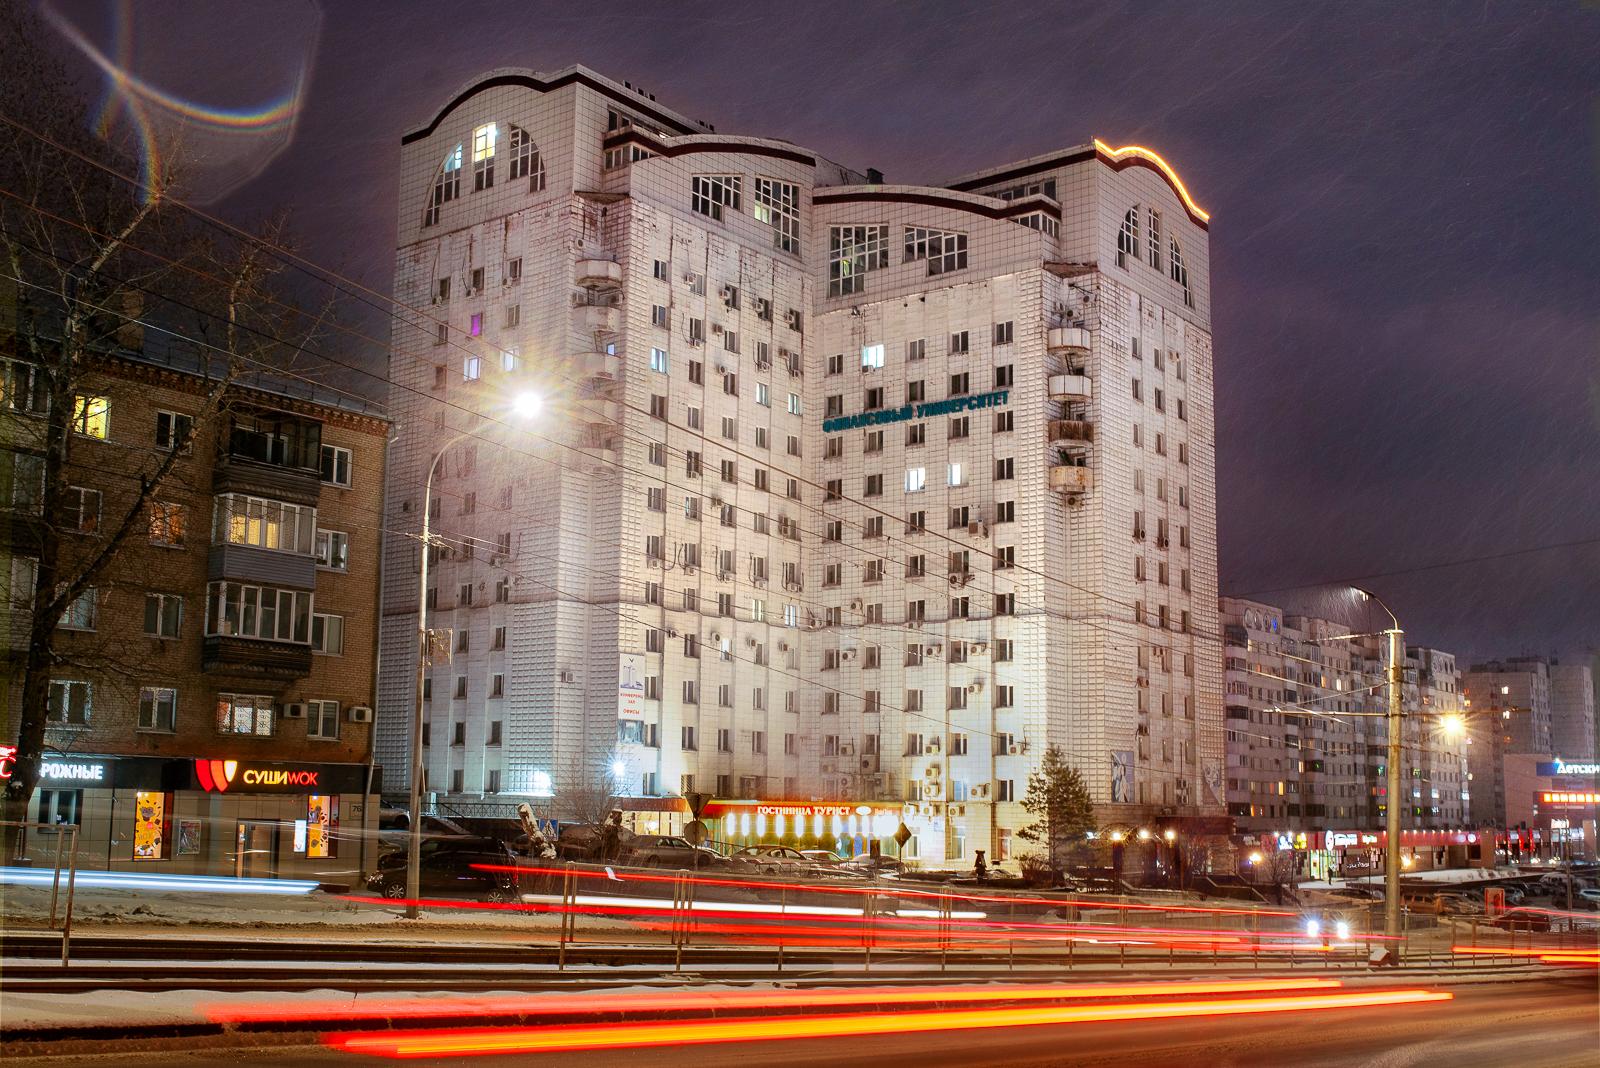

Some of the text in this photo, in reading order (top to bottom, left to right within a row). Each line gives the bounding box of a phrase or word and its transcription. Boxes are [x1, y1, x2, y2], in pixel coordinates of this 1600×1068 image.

[917, 391, 1009, 418] УНИВЕРСИТЕТ
[39, 763, 104, 780] РОЖНЫЕ
[757, 806, 850, 816] ГОСТИНИЦА ТУРИСТ
